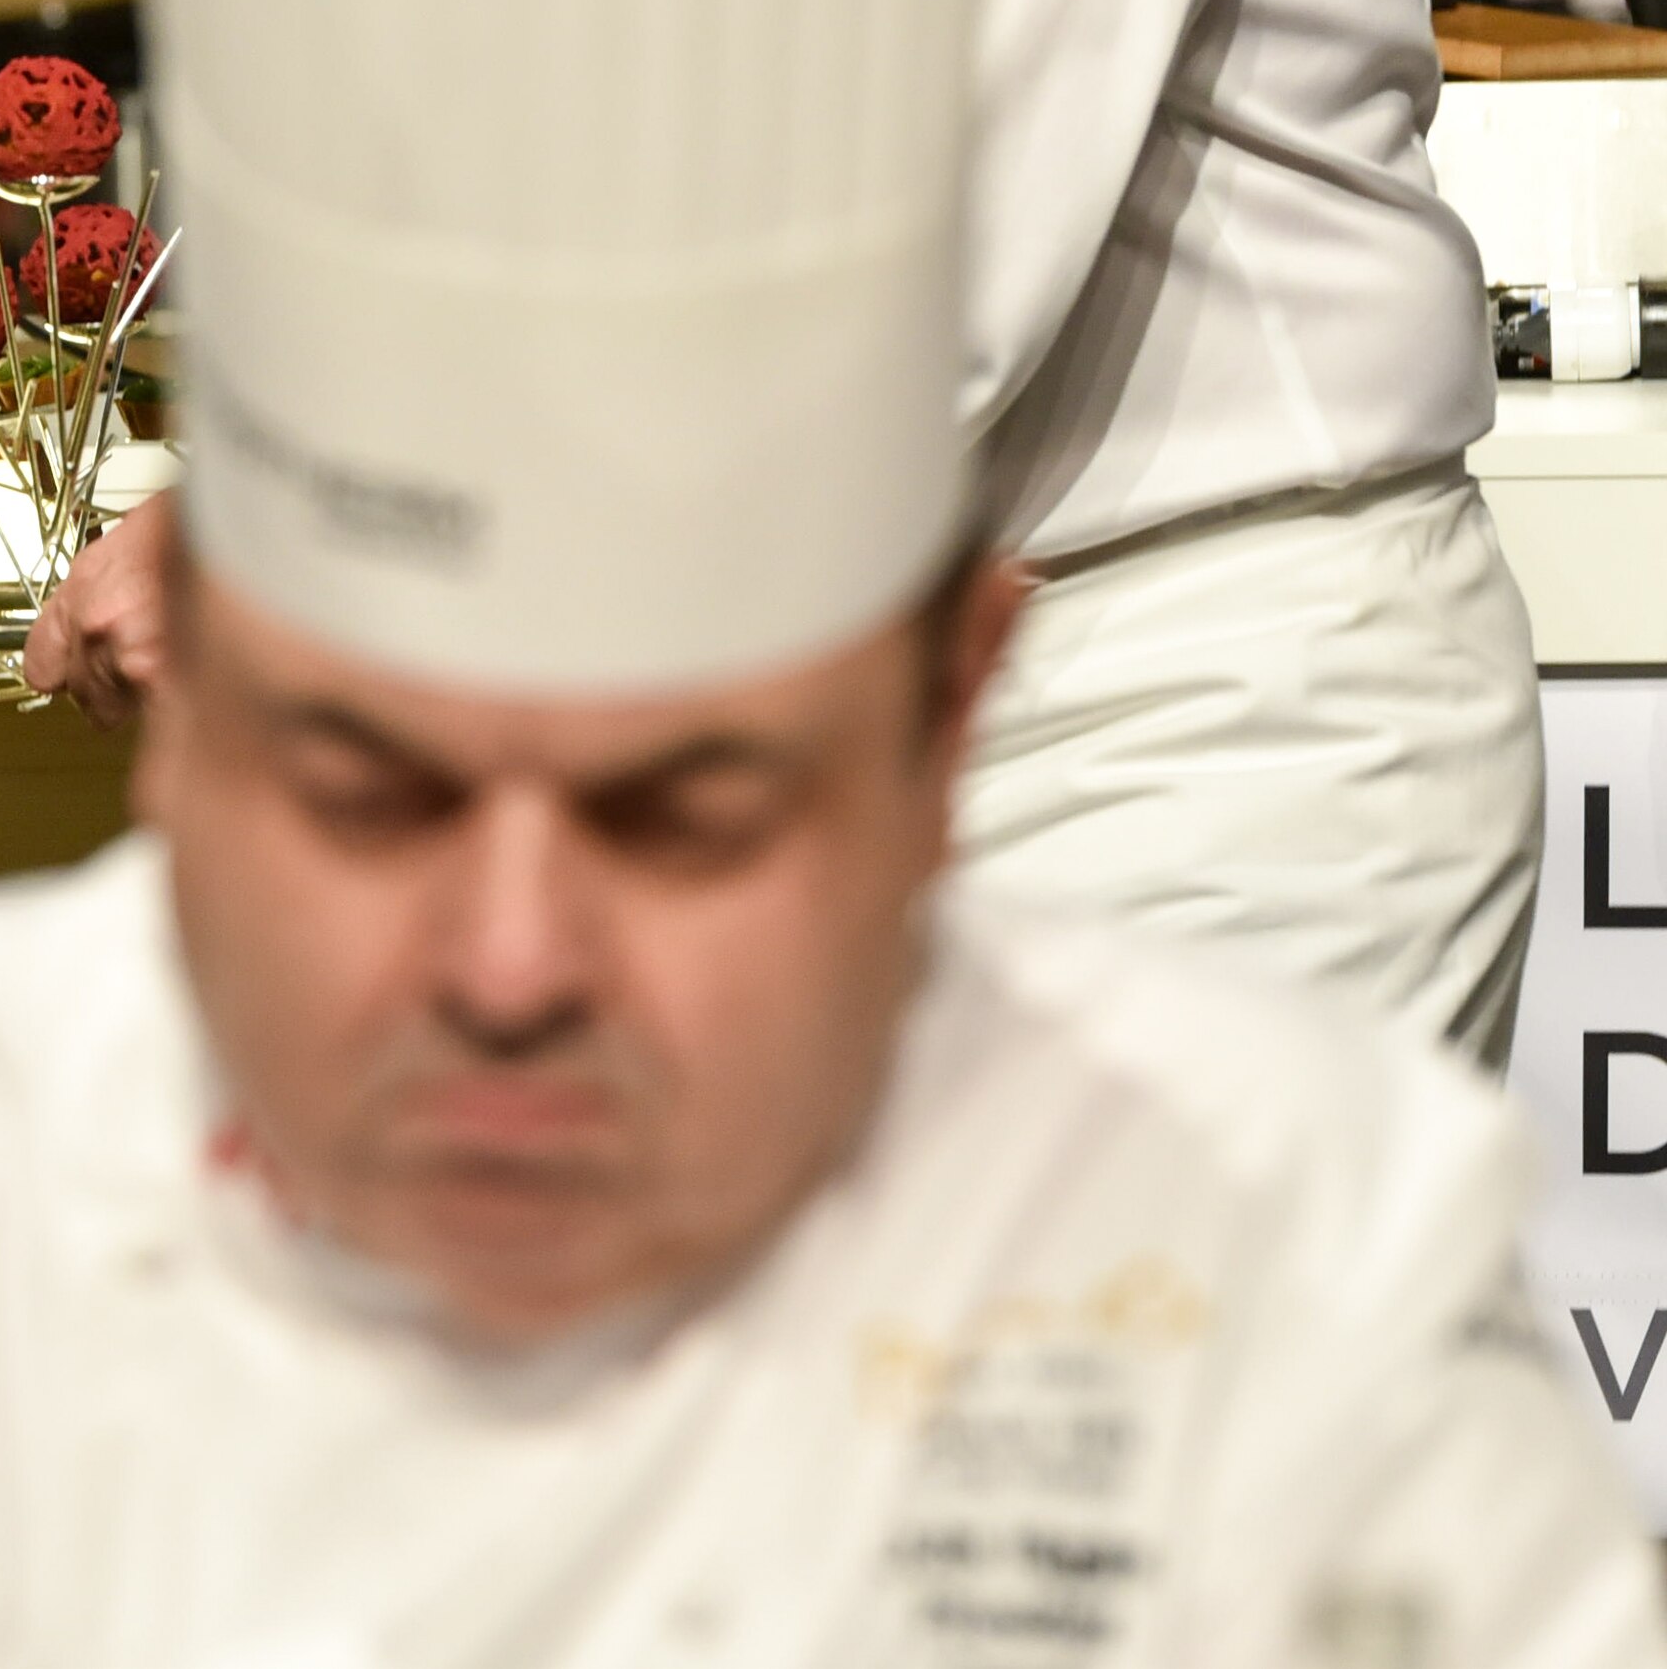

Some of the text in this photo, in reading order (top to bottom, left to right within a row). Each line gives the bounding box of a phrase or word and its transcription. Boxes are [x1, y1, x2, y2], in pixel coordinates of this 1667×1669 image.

[1584, 785, 1667, 929] L
[1582, 1032, 1667, 1175] D
[1570, 1309, 1667, 1422] V
